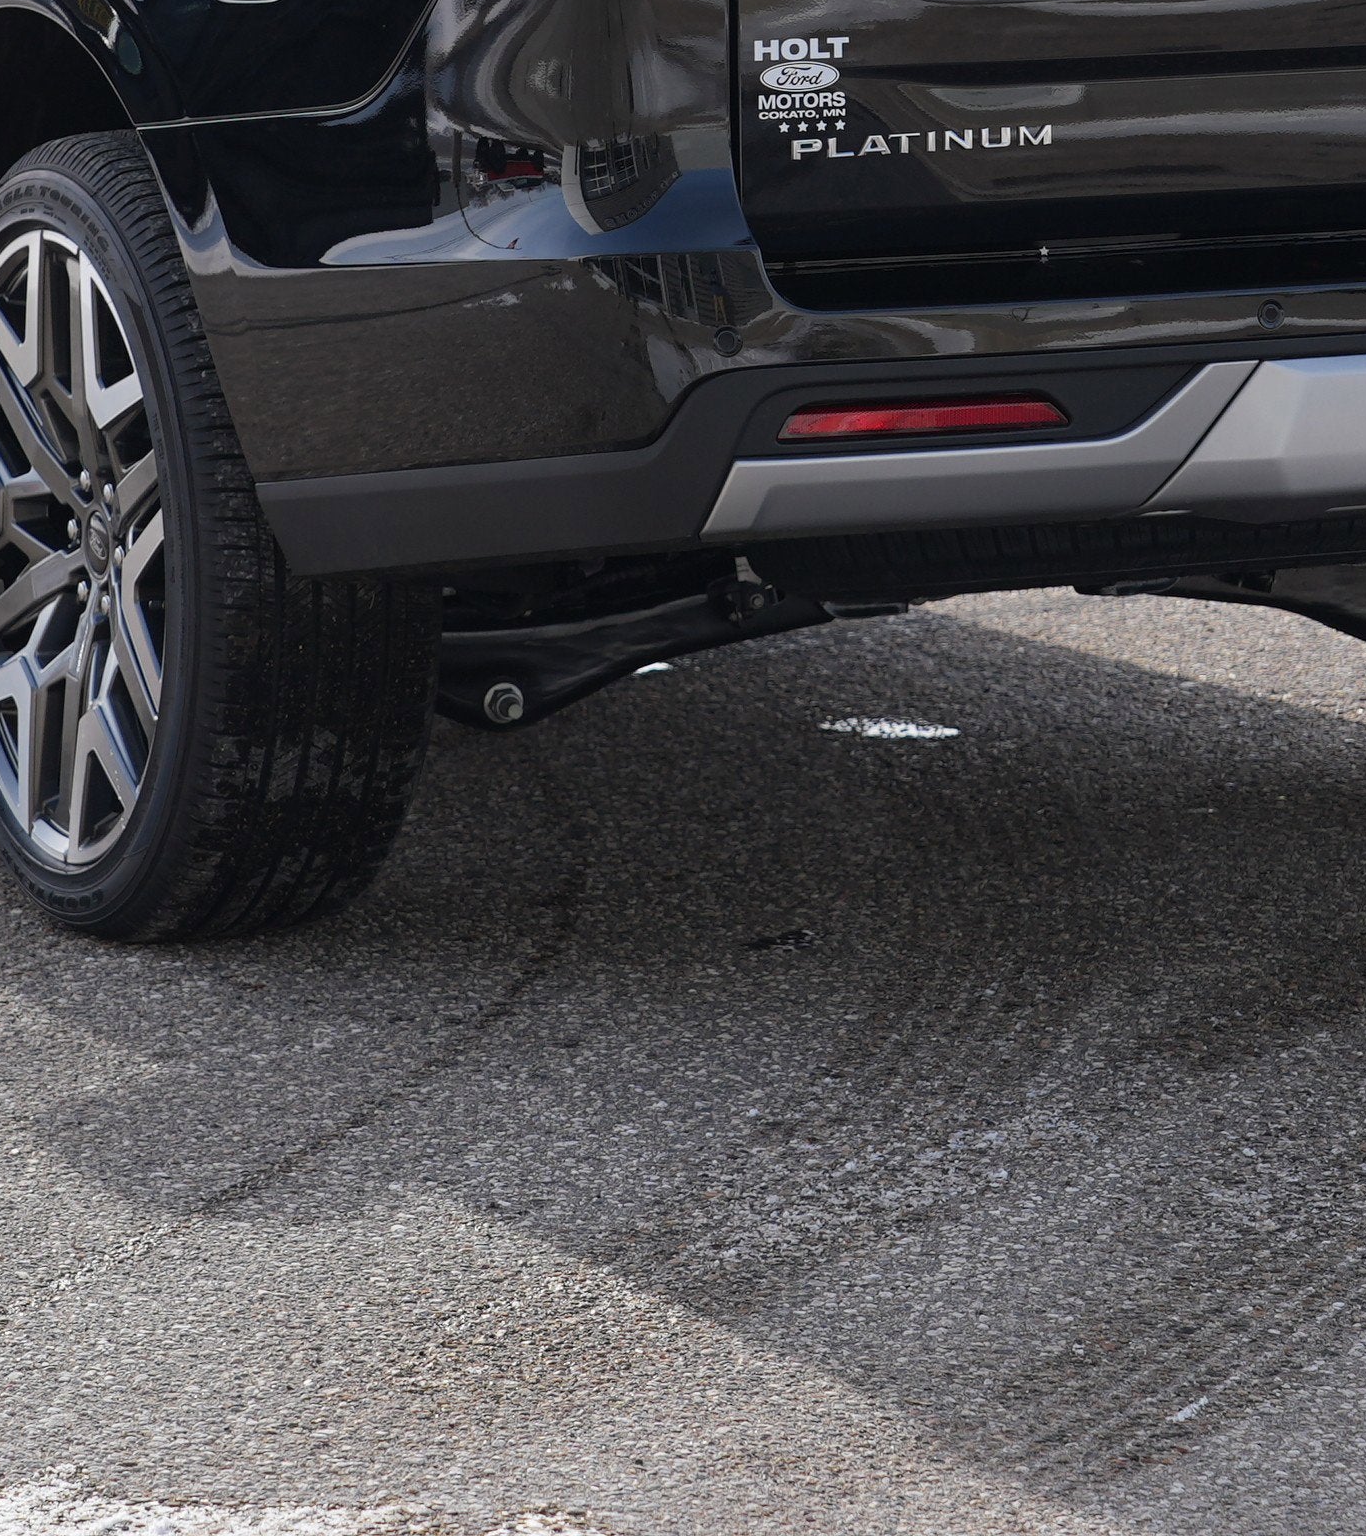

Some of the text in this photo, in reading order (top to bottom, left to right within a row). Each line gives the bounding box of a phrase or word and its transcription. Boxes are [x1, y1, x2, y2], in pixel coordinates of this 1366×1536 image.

[753, 36, 850, 62] HOLT
[776, 66, 824, 87] Ford
[758, 91, 846, 111] MOTORS
[759, 108, 846, 121] COKATO, MN
[791, 124, 1053, 161] PLATINUM
